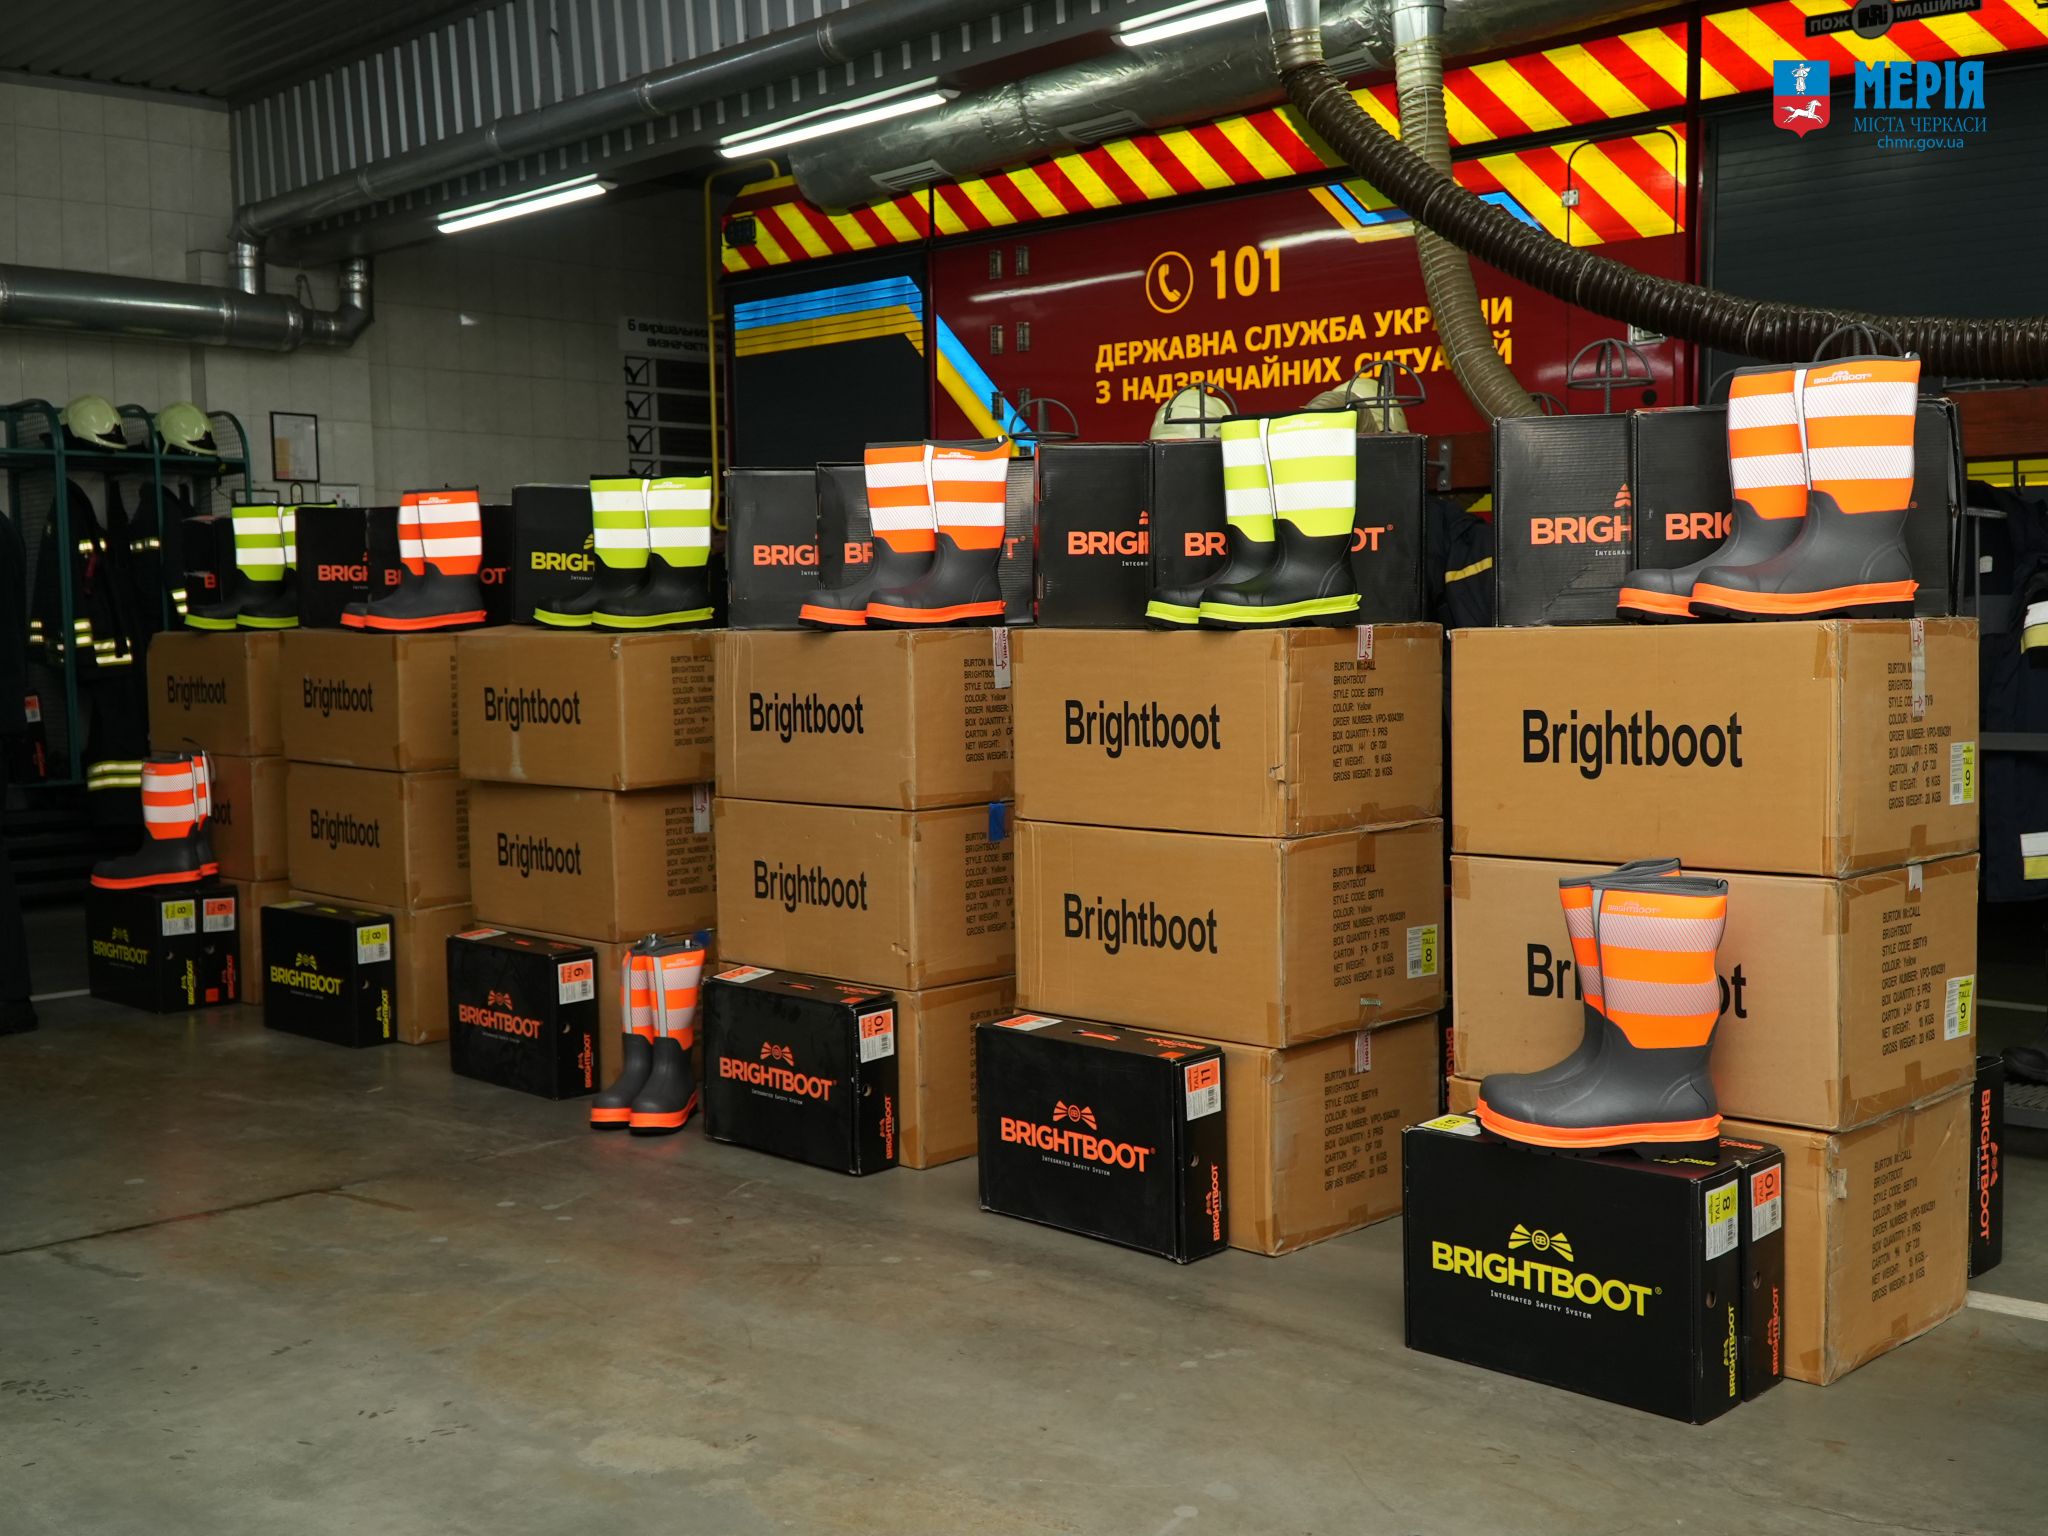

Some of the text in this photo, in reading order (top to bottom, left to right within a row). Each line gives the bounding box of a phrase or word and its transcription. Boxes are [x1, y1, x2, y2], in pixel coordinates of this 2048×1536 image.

[1810, 14, 1850, 32] ПОЖ
[1896, 0, 1976, 19] МАШИНА
[1210, 244, 1281, 300] 101
[1094, 330, 1238, 373] ДЕРЖАВНА
[1244, 312, 1366, 352] СЛУЖБА
[1122, 351, 1341, 403] НАДЗВИЧАЙНИХ
[167, 675, 227, 711] Brightboot
[303, 677, 373, 717] Brightboot
[484, 687, 581, 732] Brightboot
[749, 692, 864, 743] Brightboot
[1064, 700, 1221, 759] Brightboot
[1523, 709, 1743, 780] Brightboot
[1965, 770, 1971, 787] 9
[310, 809, 380, 849] Brightboot
[497, 832, 582, 878] Brightboot
[753, 860, 868, 912] Brightboot
[1063, 893, 1218, 955] Brightboot
[1425, 948, 1433, 962] 8
[874, 1015, 885, 1035] 10
[1960, 1002, 1967, 1019] 9
[1200, 1068, 1211, 1084] 11
[1723, 1196, 1731, 1211] 8
[1765, 1173, 1774, 1201] 10
